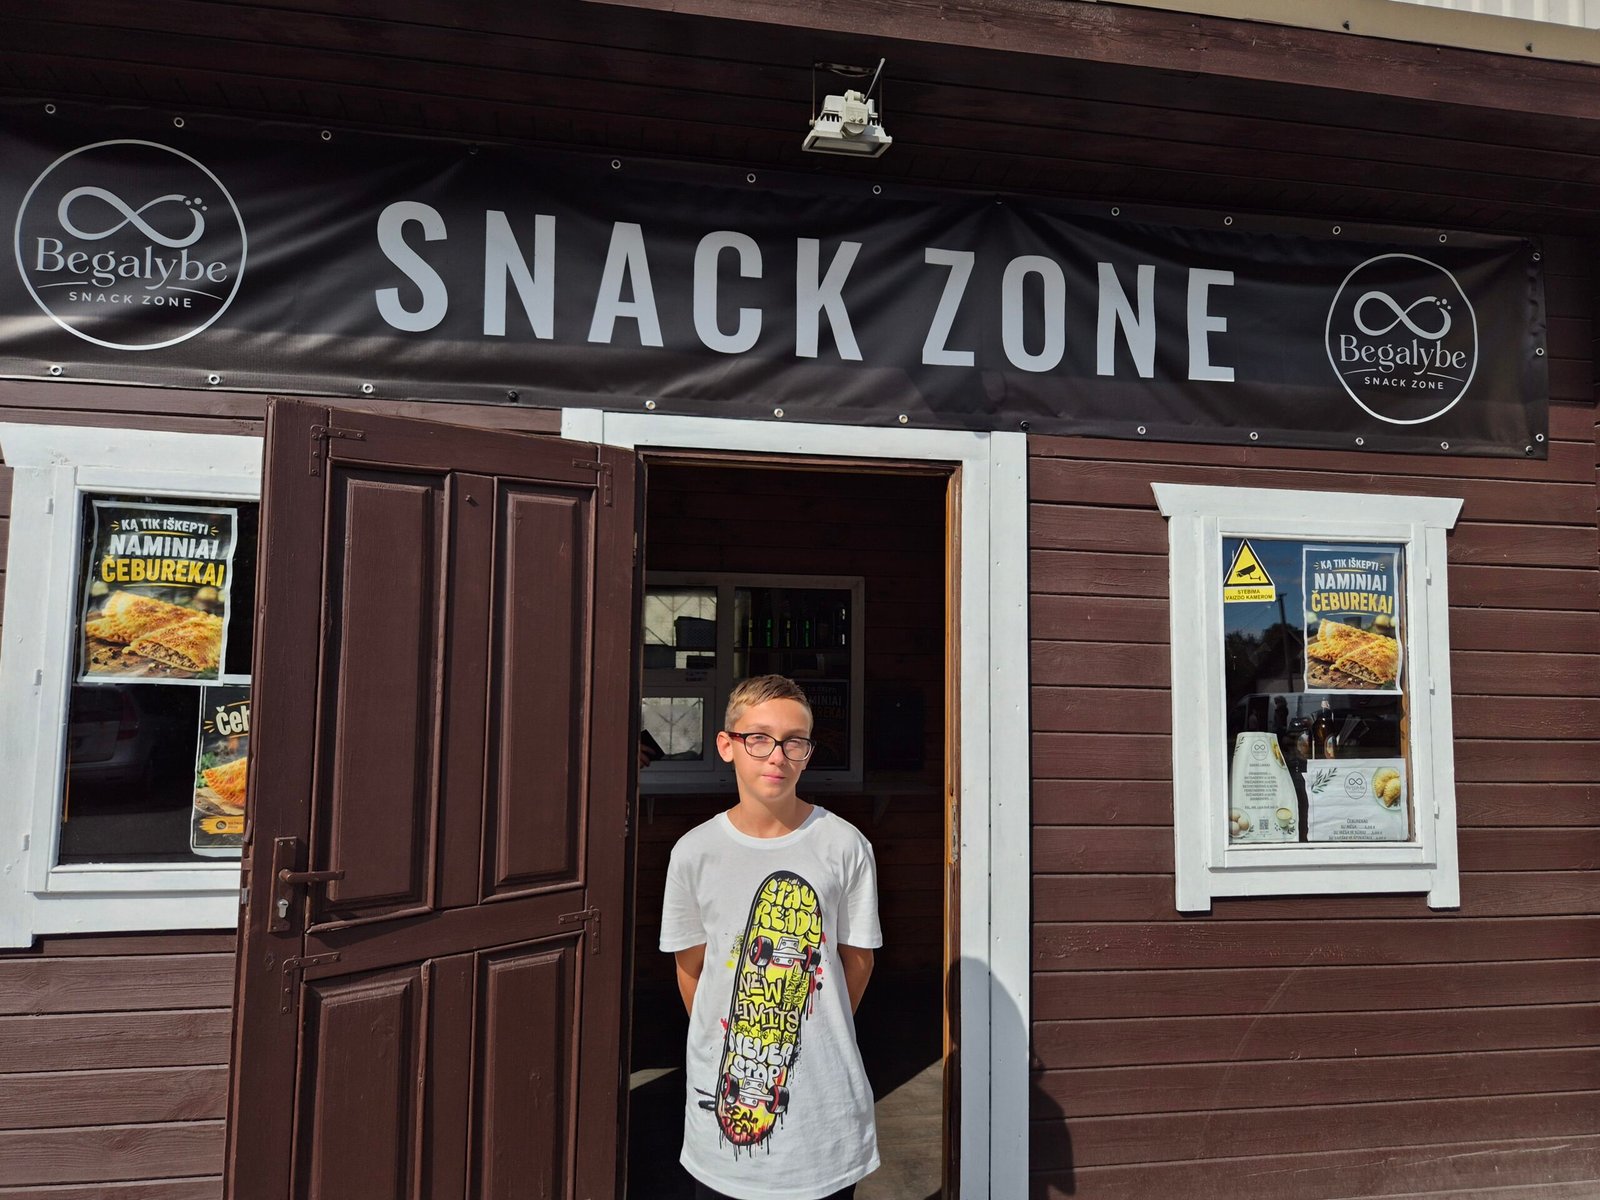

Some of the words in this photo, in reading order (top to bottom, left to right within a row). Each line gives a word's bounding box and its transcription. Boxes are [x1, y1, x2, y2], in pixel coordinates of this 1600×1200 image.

[35, 236, 228, 290] Begalybe
[68, 291, 134, 304] SNACK
[142, 295, 192, 308] ZONE
[374, 200, 863, 361] SNACK
[921, 247, 1235, 382] ZONE
[1339, 334, 1467, 375] Begalybe
[1364, 376, 1406, 387] SNACK
[1411, 380, 1444, 389] ZONE
[121, 518, 140, 532] KĄ
[141, 518, 160, 530] TIK
[163, 517, 209, 535] IŠKEPTI
[109, 534, 220, 560] NAMINIAI
[101, 555, 225, 587] ČEBUREKAI
[1320, 560, 1332, 571] KĄ
[1333, 559, 1347, 568] TIK
[1348, 557, 1379, 572] IŠKEPTI
[1314, 573, 1388, 591] NAMINIAI
[1311, 590, 1393, 614] ČEBUREKAI
[760, 878, 817, 914] STAY
[752, 899, 822, 943] READY
[738, 972, 783, 1006] NEW
[728, 1030, 795, 1067] NEVER
[729, 1054, 781, 1089] STOP
